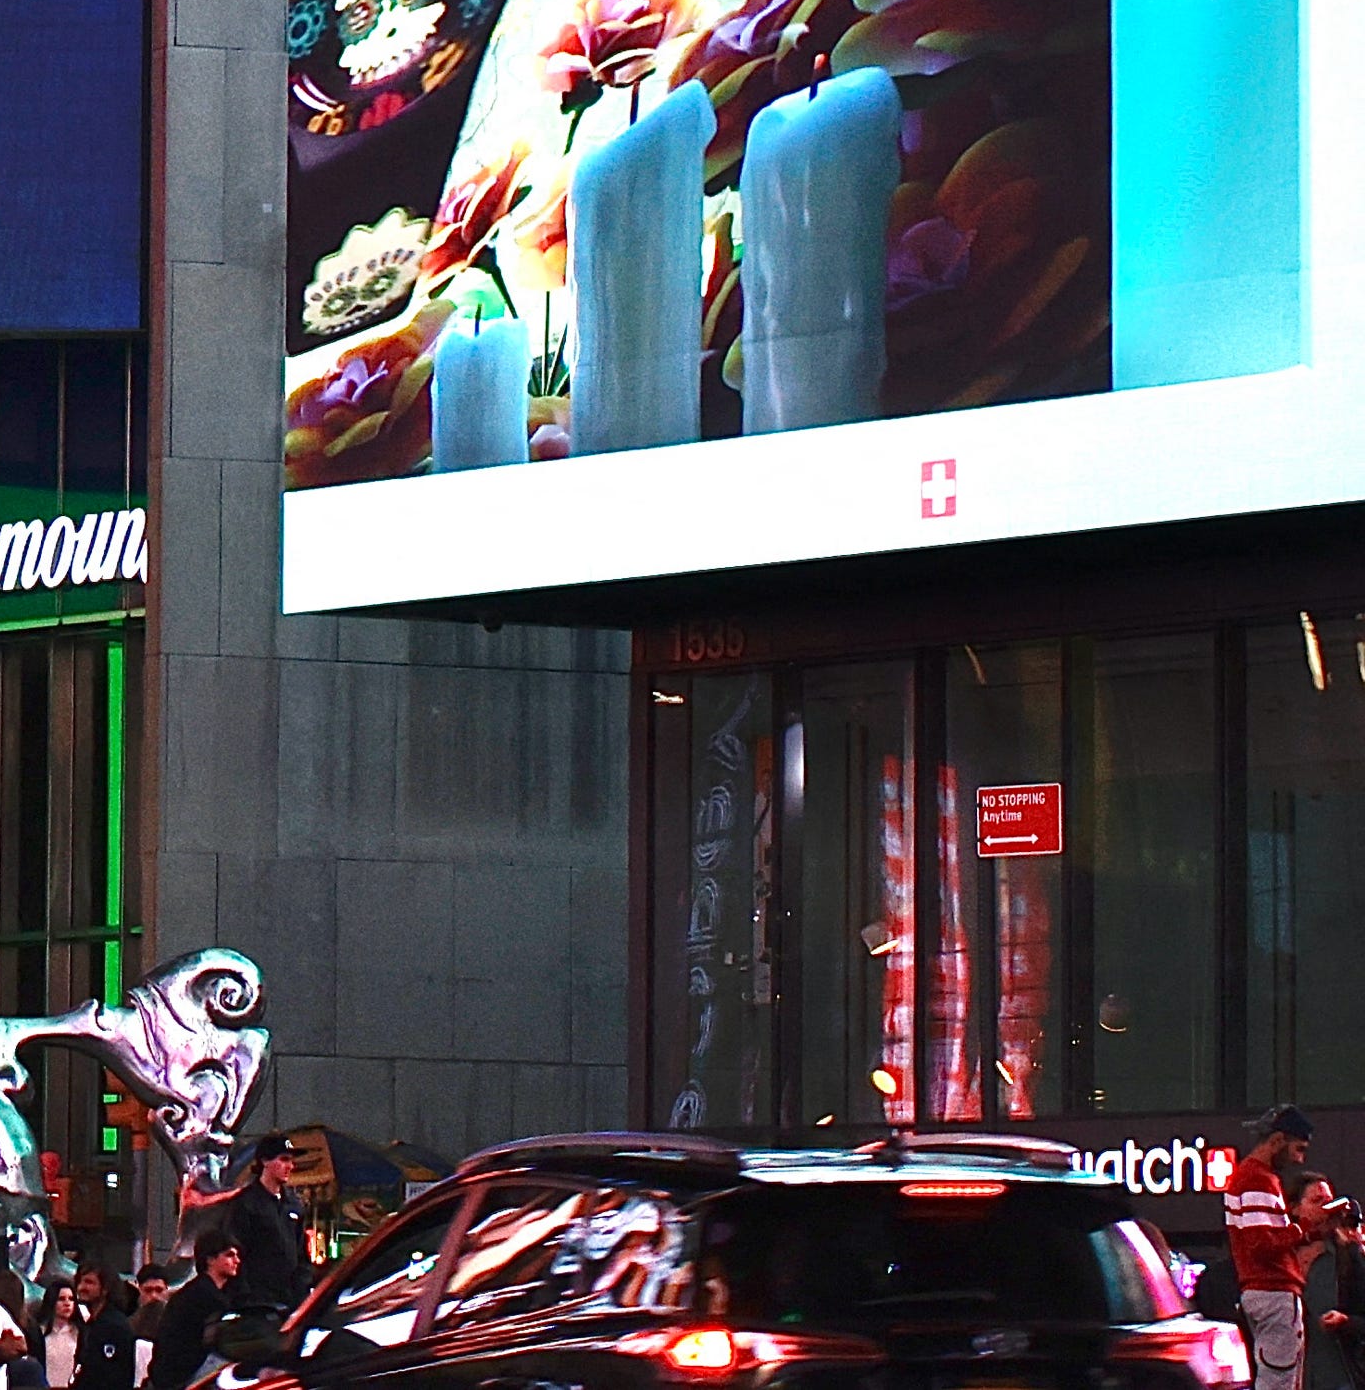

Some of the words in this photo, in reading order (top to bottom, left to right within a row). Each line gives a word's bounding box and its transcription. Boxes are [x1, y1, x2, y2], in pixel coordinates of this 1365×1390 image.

[982, 795, 996, 807] NO
[998, 792, 1046, 807] STOPPING
[982, 810, 1022, 825] Anytime
